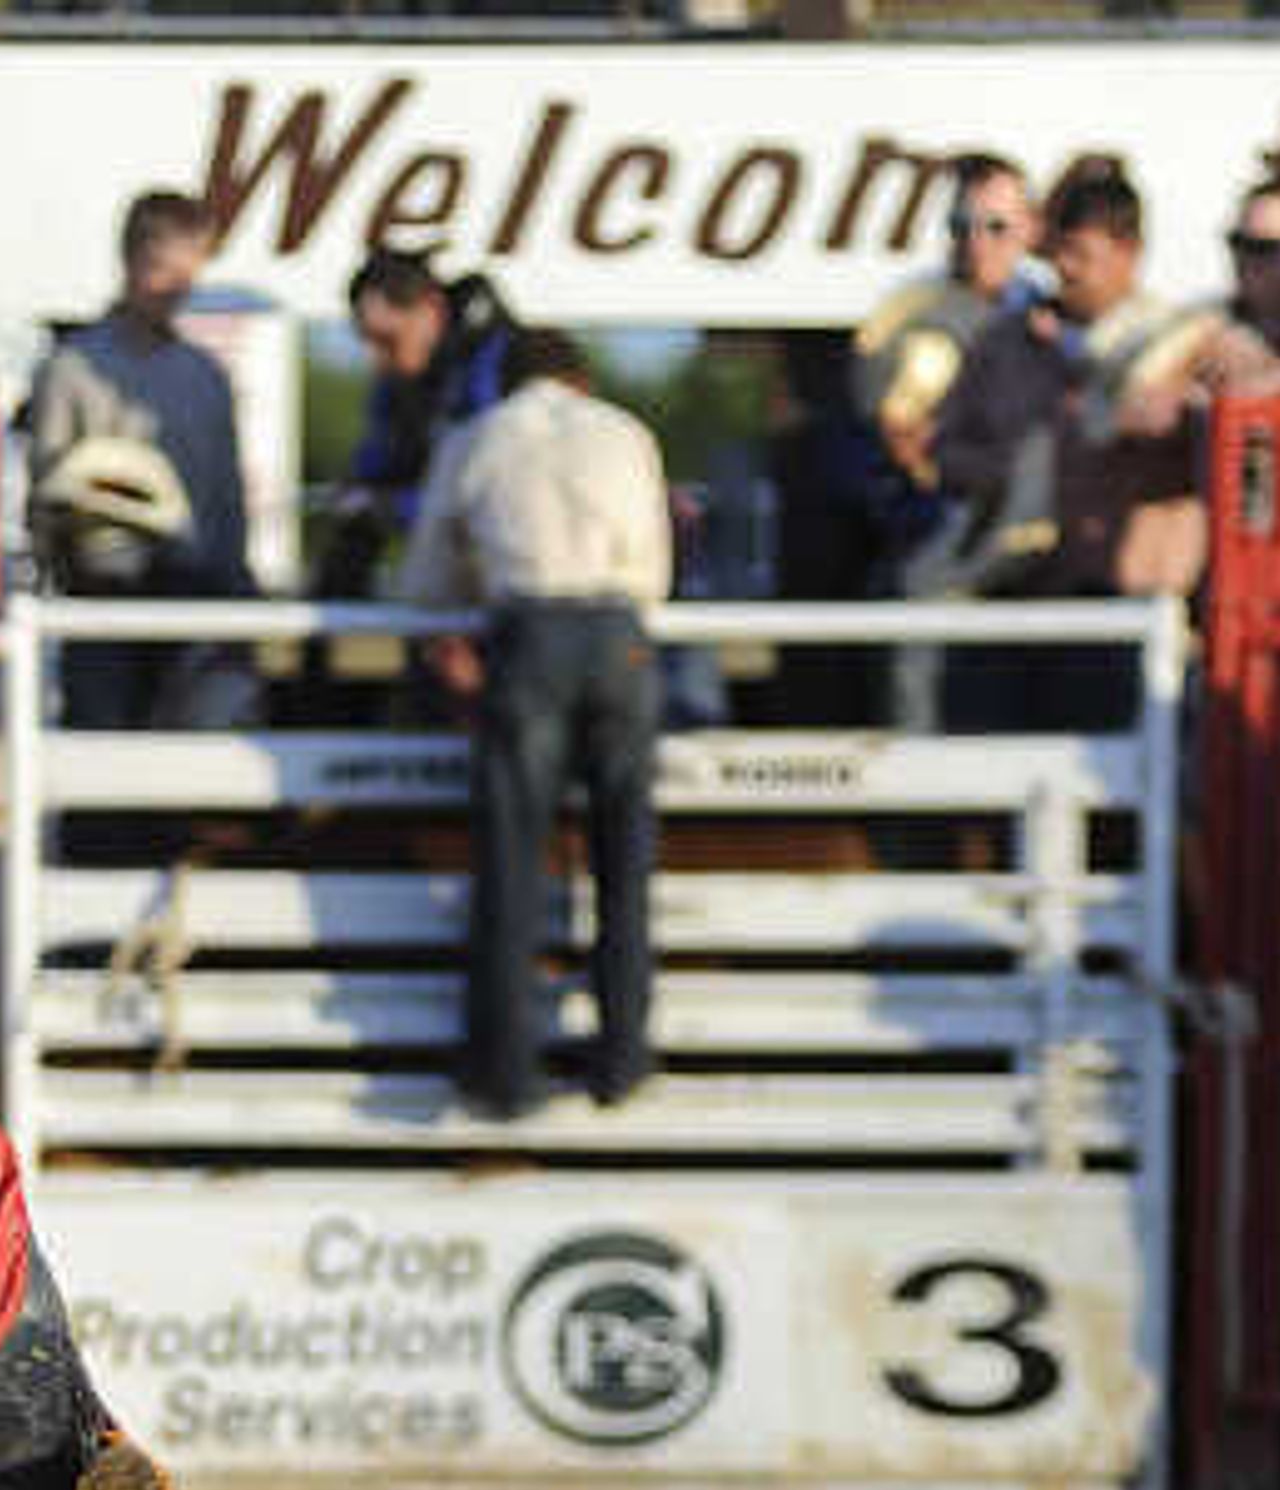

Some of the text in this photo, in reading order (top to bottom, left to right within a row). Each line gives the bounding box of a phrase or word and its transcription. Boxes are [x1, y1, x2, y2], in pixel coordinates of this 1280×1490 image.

[203, 78, 1115, 260] Welcom
[304, 1218, 491, 1292] Crop
[72, 1298, 490, 1366] Production
[883, 1258, 1061, 1418] 3
[160, 1376, 490, 1444] Services
